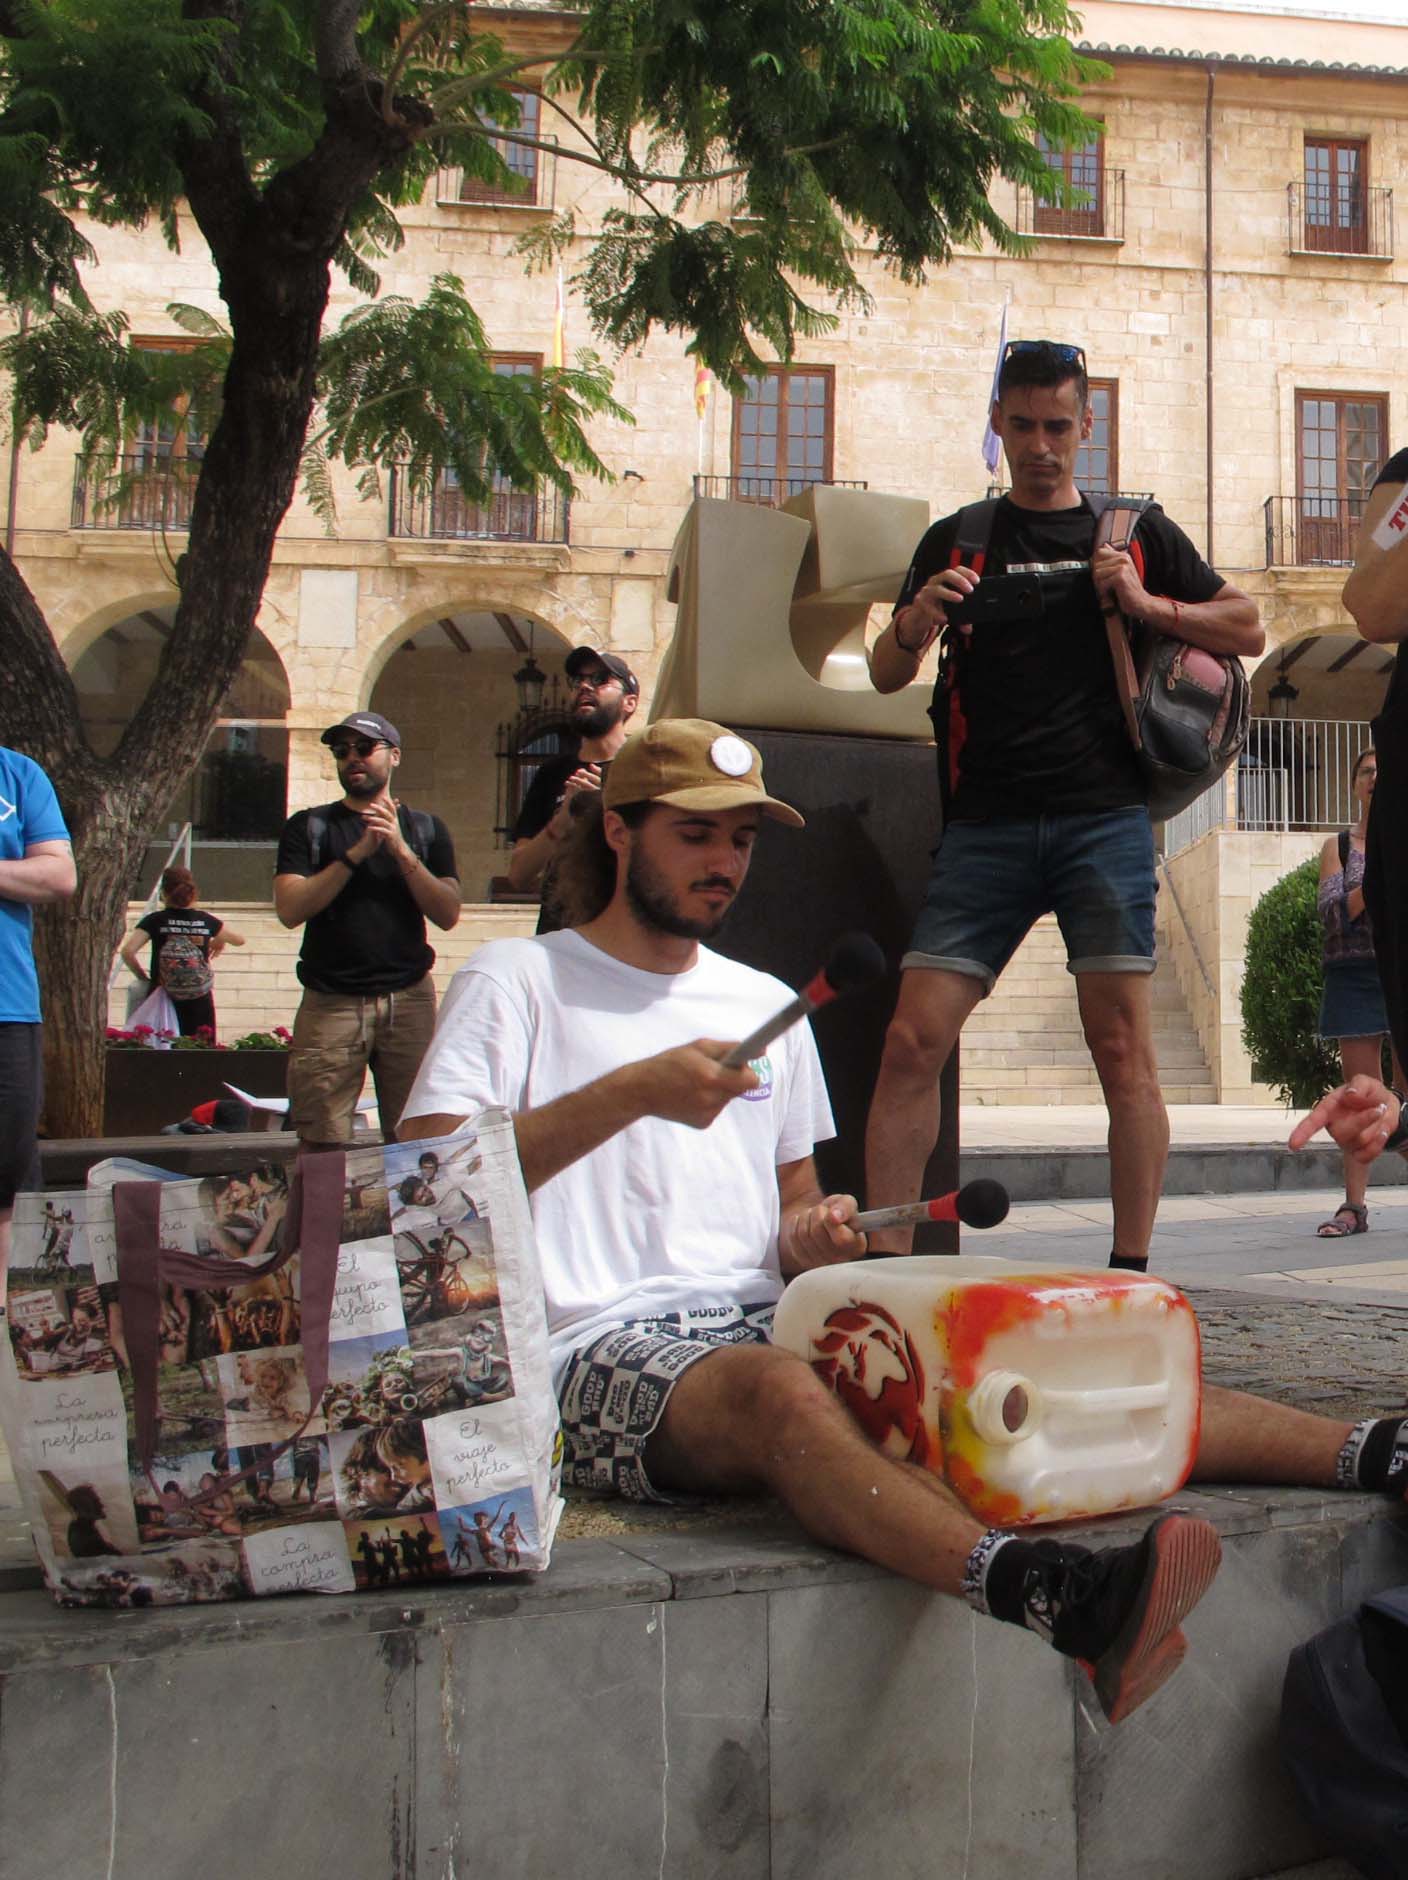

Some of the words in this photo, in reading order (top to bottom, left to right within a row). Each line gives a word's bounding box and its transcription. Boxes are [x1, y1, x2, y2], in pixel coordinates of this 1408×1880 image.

[41, 1424, 116, 1457] perfecta
[460, 1418, 482, 1440] El
[454, 1443, 497, 1464] viaje
[446, 1456, 513, 1494] perfecto
